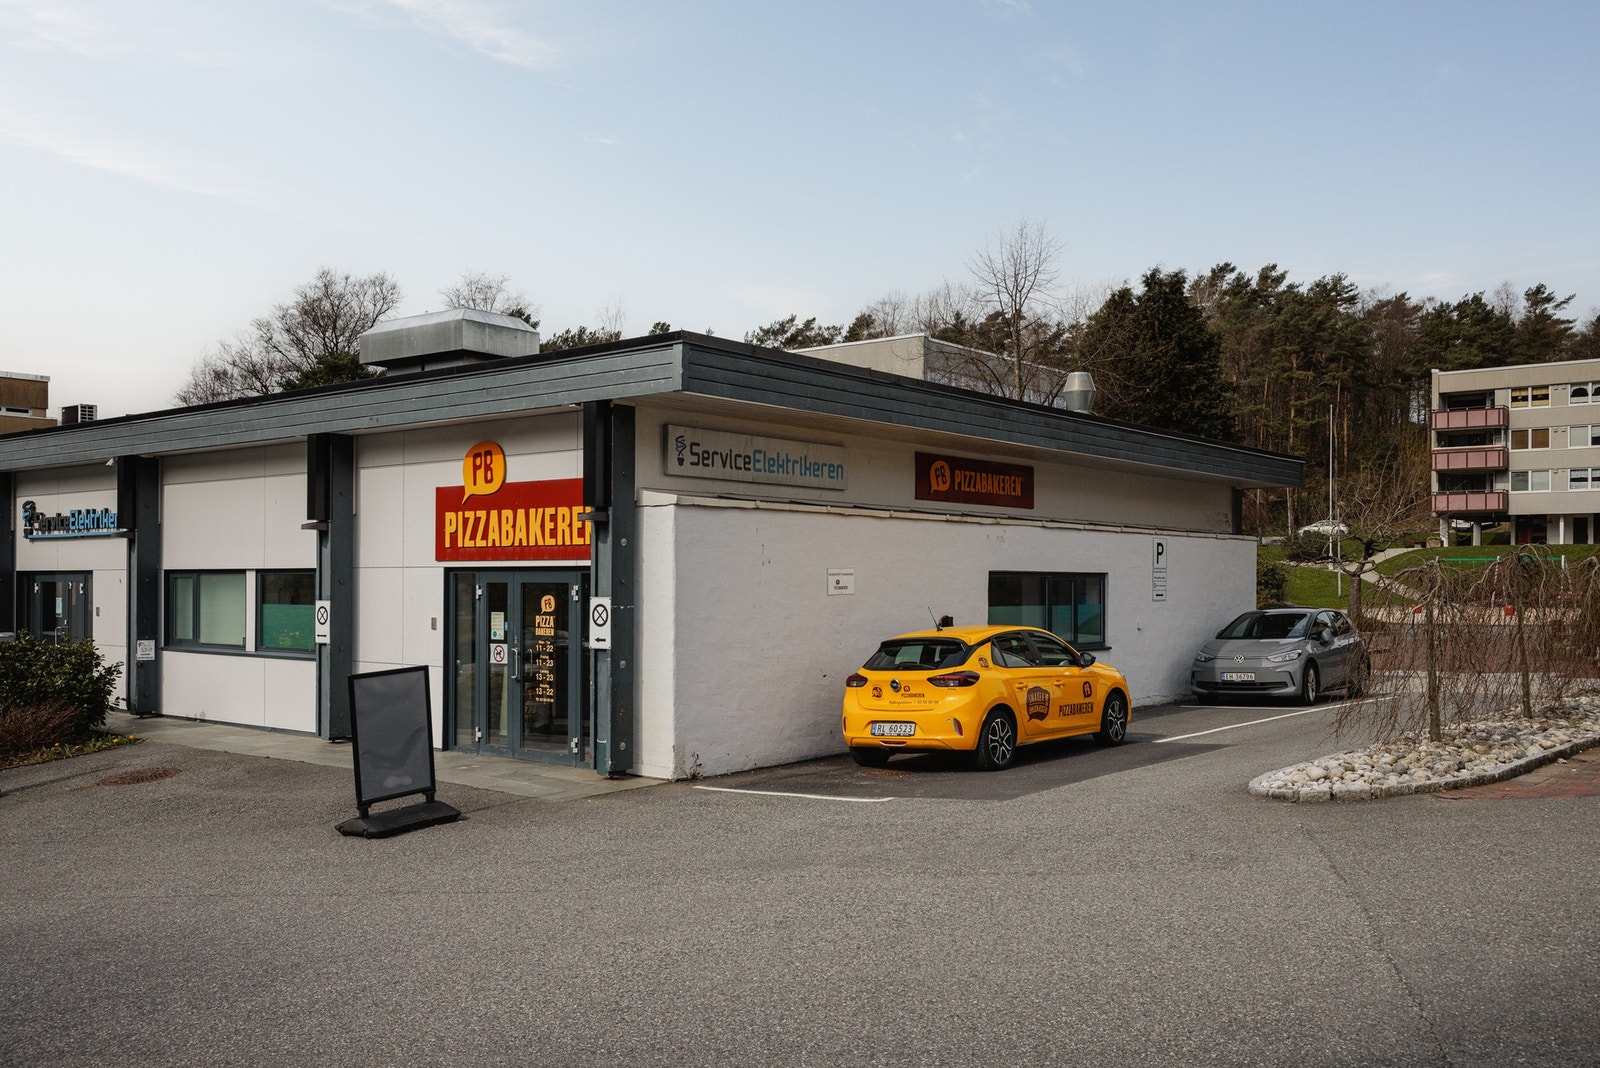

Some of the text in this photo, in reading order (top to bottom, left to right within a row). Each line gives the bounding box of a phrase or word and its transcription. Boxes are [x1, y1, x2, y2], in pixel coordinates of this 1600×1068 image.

[472, 449, 494, 487] PB
[690, 442, 844, 480] ServiceElektrikeren
[954, 470, 1022, 496] PIZZABAKEREN
[1156, 542, 1164, 564] P
[535, 615, 554, 627] PIZZA
[1058, 702, 1095, 718] PIZZABAKEREN
[876, 724, 913, 734] RL 60523
